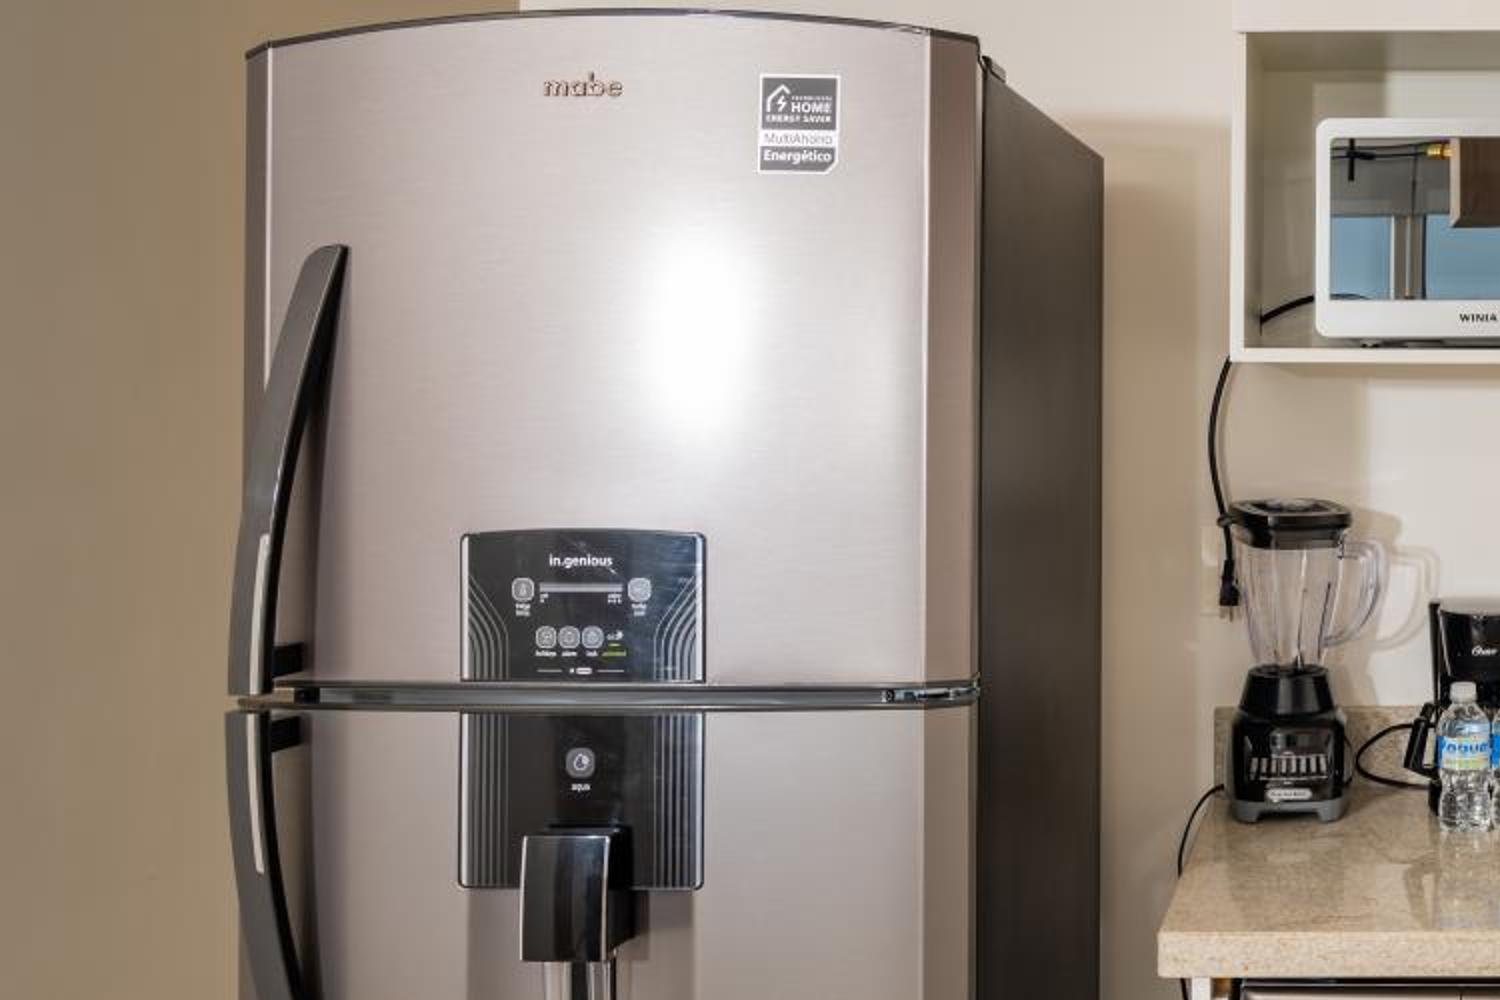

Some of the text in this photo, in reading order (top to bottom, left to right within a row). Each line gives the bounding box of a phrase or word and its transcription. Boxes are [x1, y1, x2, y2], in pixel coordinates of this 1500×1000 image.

[543, 72, 624, 97] mabe
[791, 101, 832, 113] HOME
[1459, 313, 1498, 323] WINIA
[549, 553, 614, 569] in.genious
